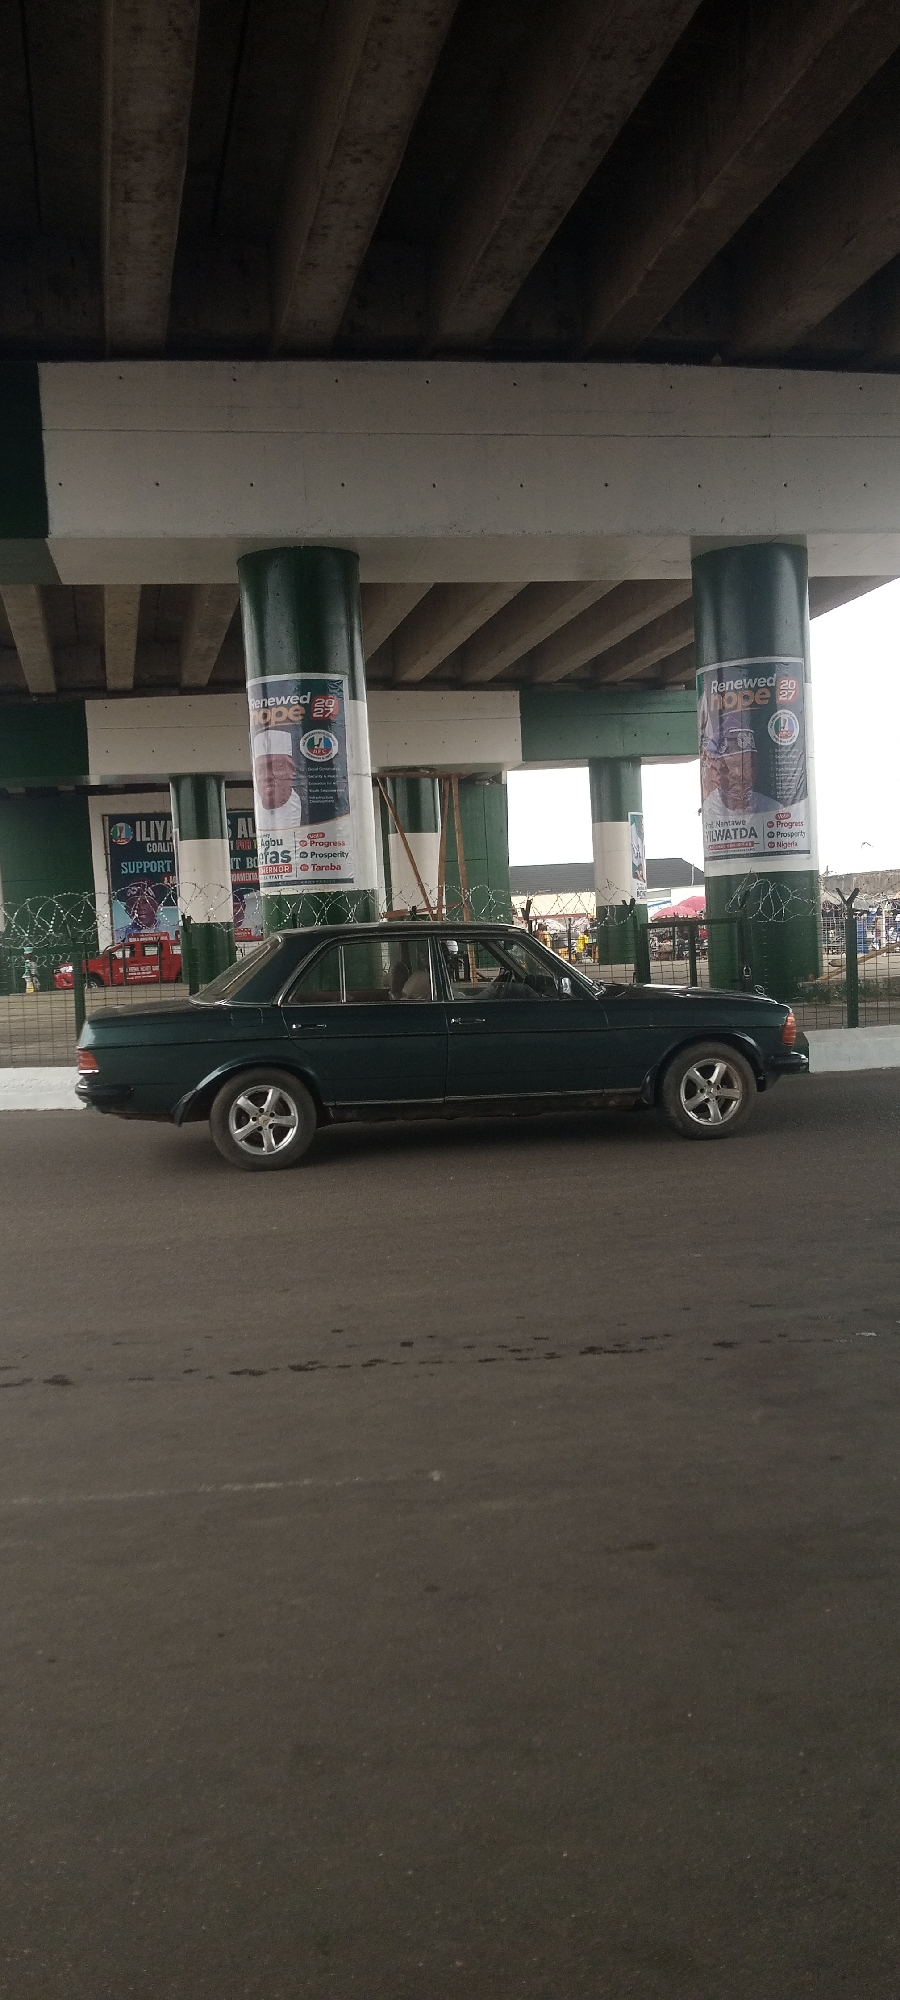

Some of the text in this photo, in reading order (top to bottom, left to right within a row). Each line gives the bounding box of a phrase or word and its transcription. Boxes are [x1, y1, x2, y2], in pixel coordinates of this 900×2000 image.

[711, 674, 776, 694] Renewed
[780, 680, 796, 690] 20
[779, 690, 795, 701] 27
[250, 692, 311, 710] Renewed
[314, 698, 335, 708] 20
[312, 708, 334, 718] 27
[716, 820, 747, 828] Nentawe
[776, 821, 804, 829] Progress
[776, 831, 806, 839] Prosperity
[310, 840, 346, 848] Progress
[776, 841, 798, 850] Nigeria
[310, 851, 349, 859] Prosperity
[120, 860, 172, 874] SUPPORT
[311, 863, 342, 872] Taraba
